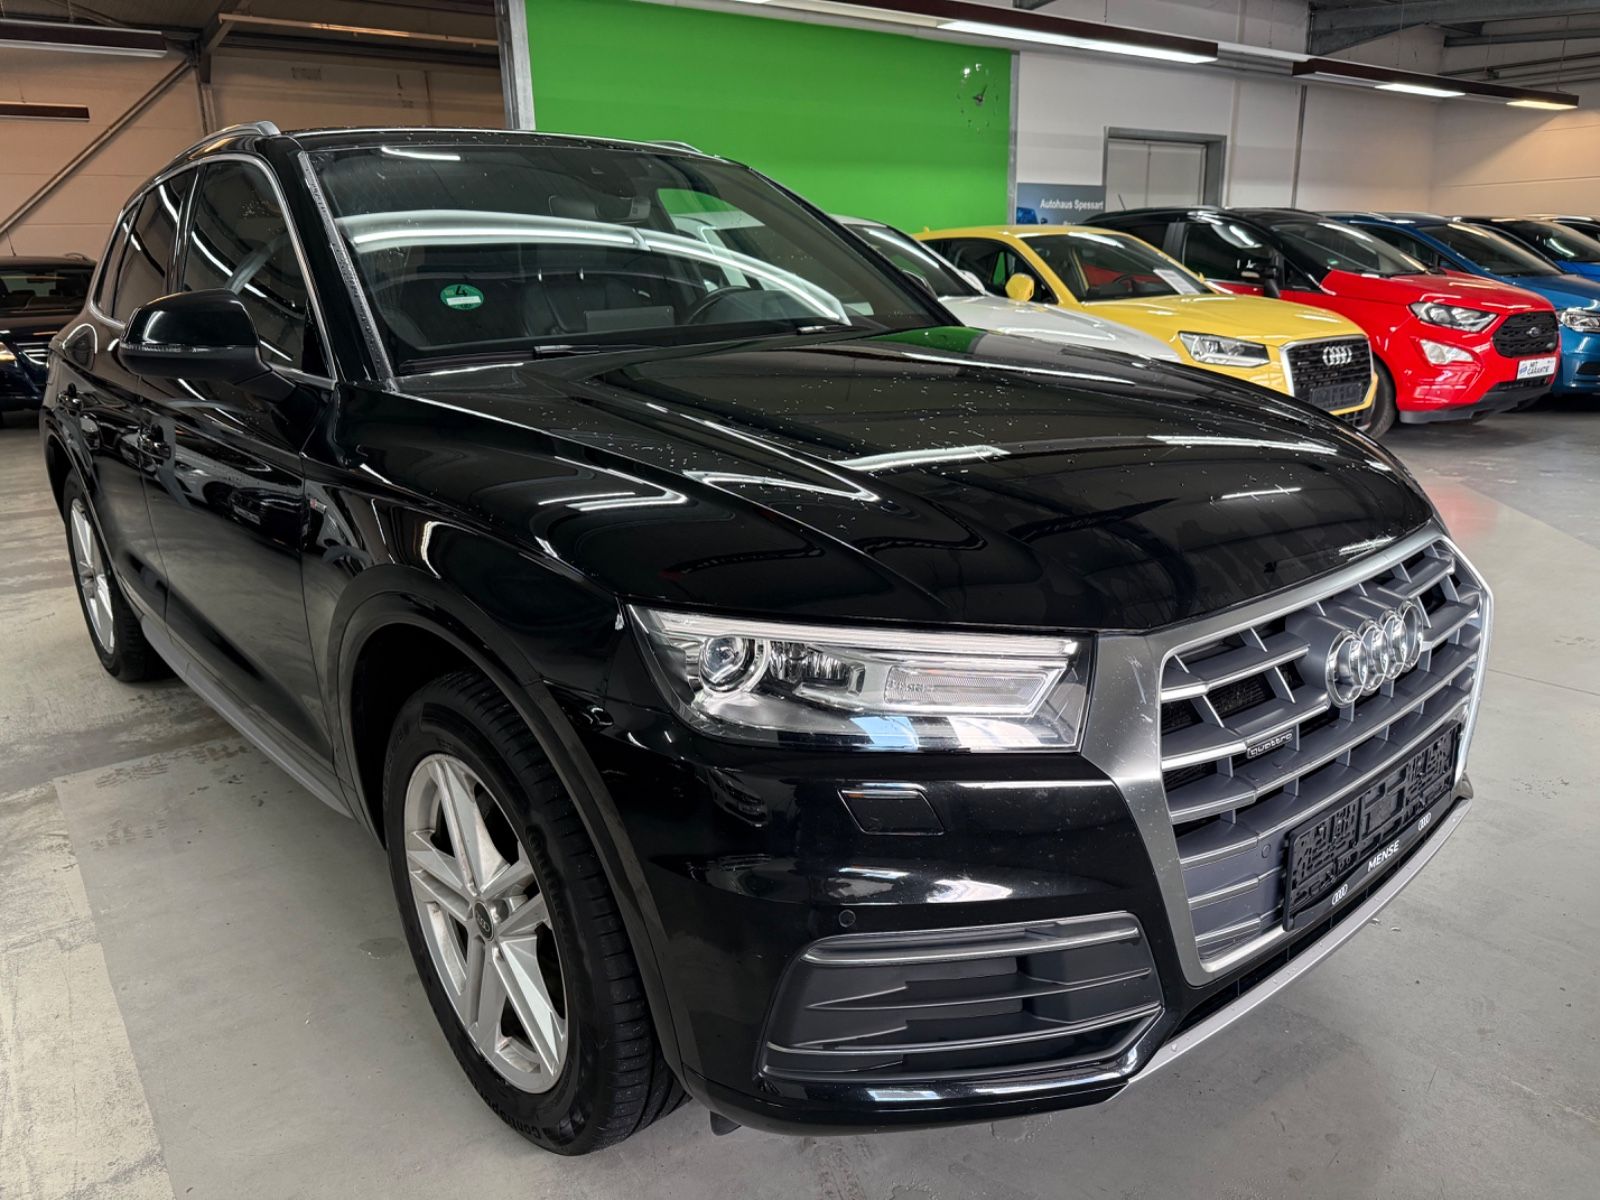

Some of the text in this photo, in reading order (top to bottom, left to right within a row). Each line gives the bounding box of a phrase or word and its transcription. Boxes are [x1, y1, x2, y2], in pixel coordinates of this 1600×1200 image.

[1040, 198, 1104, 212] Autohaus Spessart
[455, 286, 467, 296] 4
[1250, 733, 1293, 756] quattro
[1367, 839, 1401, 872] MENSE
